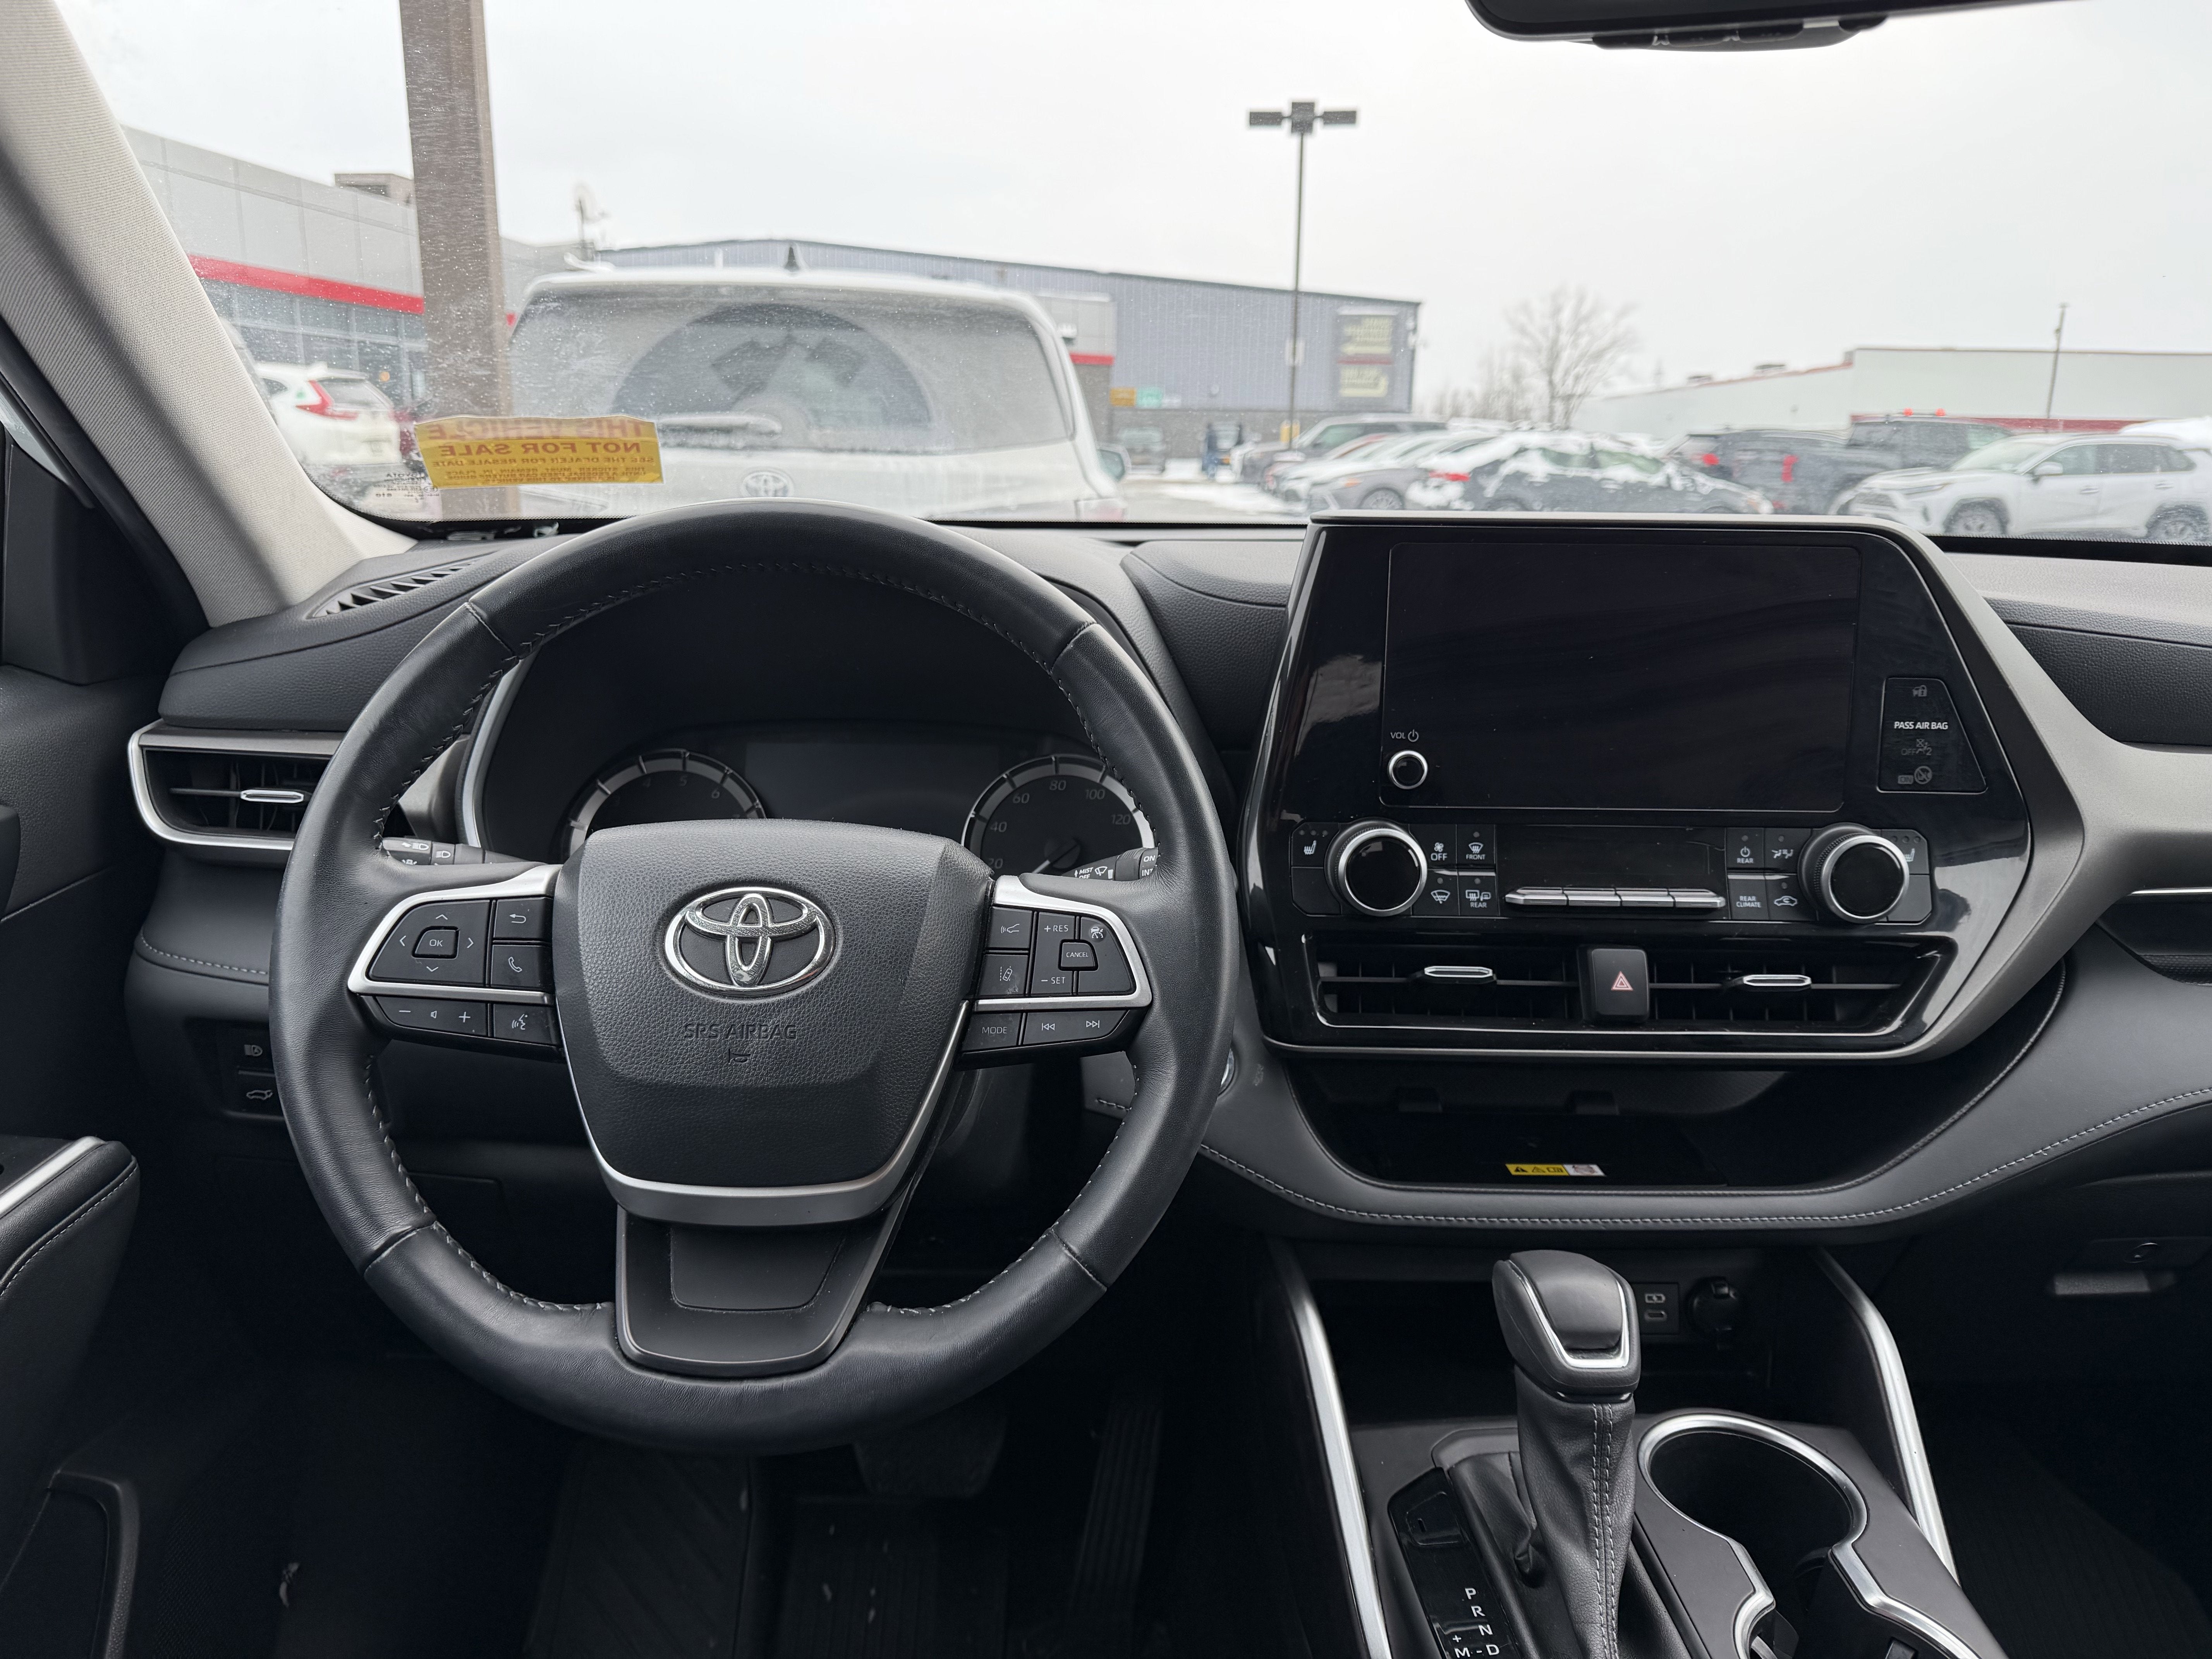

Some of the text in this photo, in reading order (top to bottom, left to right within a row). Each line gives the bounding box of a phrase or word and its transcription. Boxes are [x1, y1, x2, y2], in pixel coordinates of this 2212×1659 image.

[678, 776, 687, 787] 5
[1049, 780, 1066, 790] 80
[711, 788, 720, 799] 6
[1013, 793, 1030, 803] 60
[1085, 789, 1106, 800] 100
[1111, 814, 1131, 825] 120
[990, 821, 1007, 832] 40
[1431, 853, 1448, 861] OFF
[429, 939, 443, 947] OK
[684, 1024, 798, 1041] SRS AIRBAG
[1465, 1588, 1477, 1600] P
[1471, 1606, 1486, 1617] R
[1479, 1624, 1493, 1636] N
